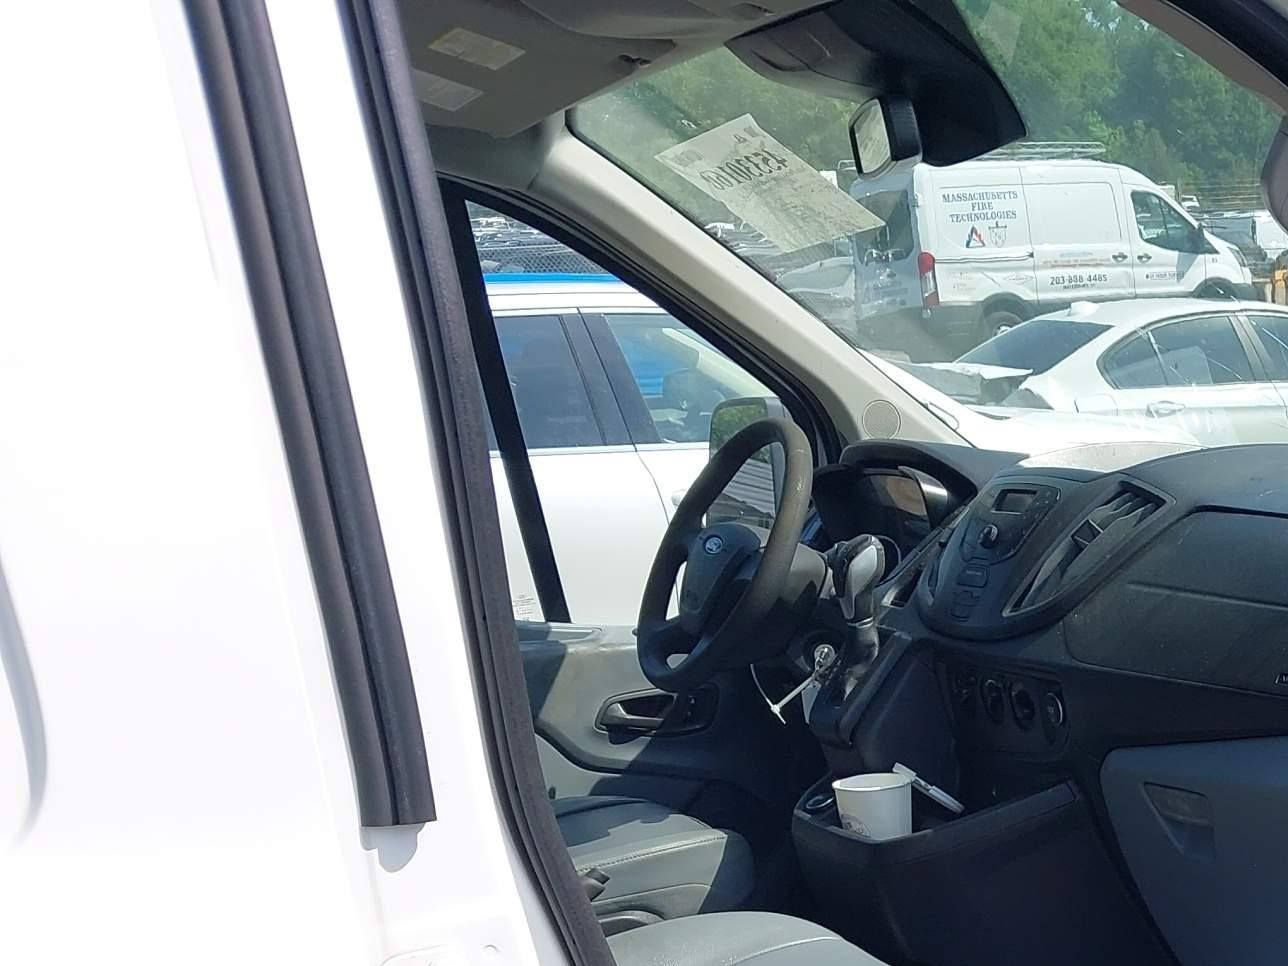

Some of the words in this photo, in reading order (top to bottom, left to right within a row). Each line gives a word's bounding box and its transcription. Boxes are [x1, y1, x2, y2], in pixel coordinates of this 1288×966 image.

[941, 190, 1018, 203] MASSACHUSETTS
[971, 201, 994, 212] FIRE
[948, 210, 1017, 223] TECHNOLOGIES
